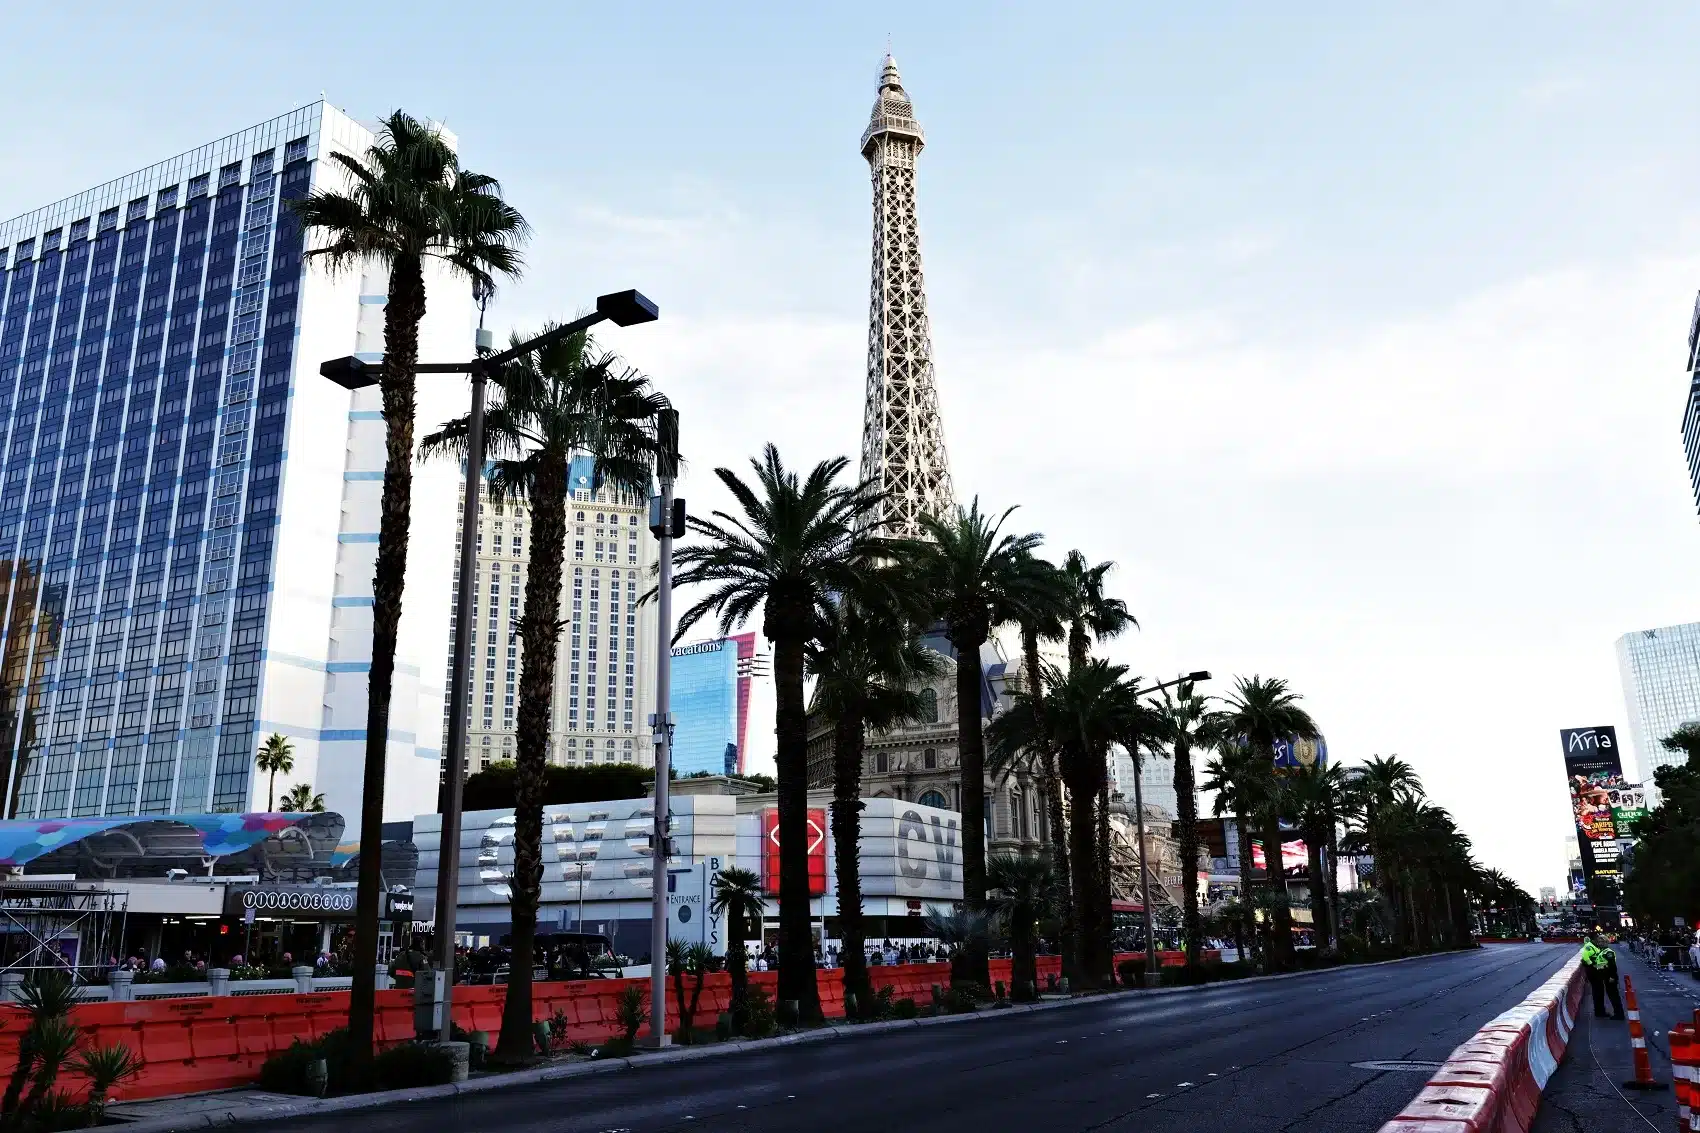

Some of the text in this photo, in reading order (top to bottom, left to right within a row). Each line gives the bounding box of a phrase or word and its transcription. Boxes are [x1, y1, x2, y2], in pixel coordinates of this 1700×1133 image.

[670, 641, 722, 657] vacations
[898, 810, 957, 890] CV
[245, 894, 351, 909] VIVA VEGAS
[670, 894, 701, 905] ENTRANCE
